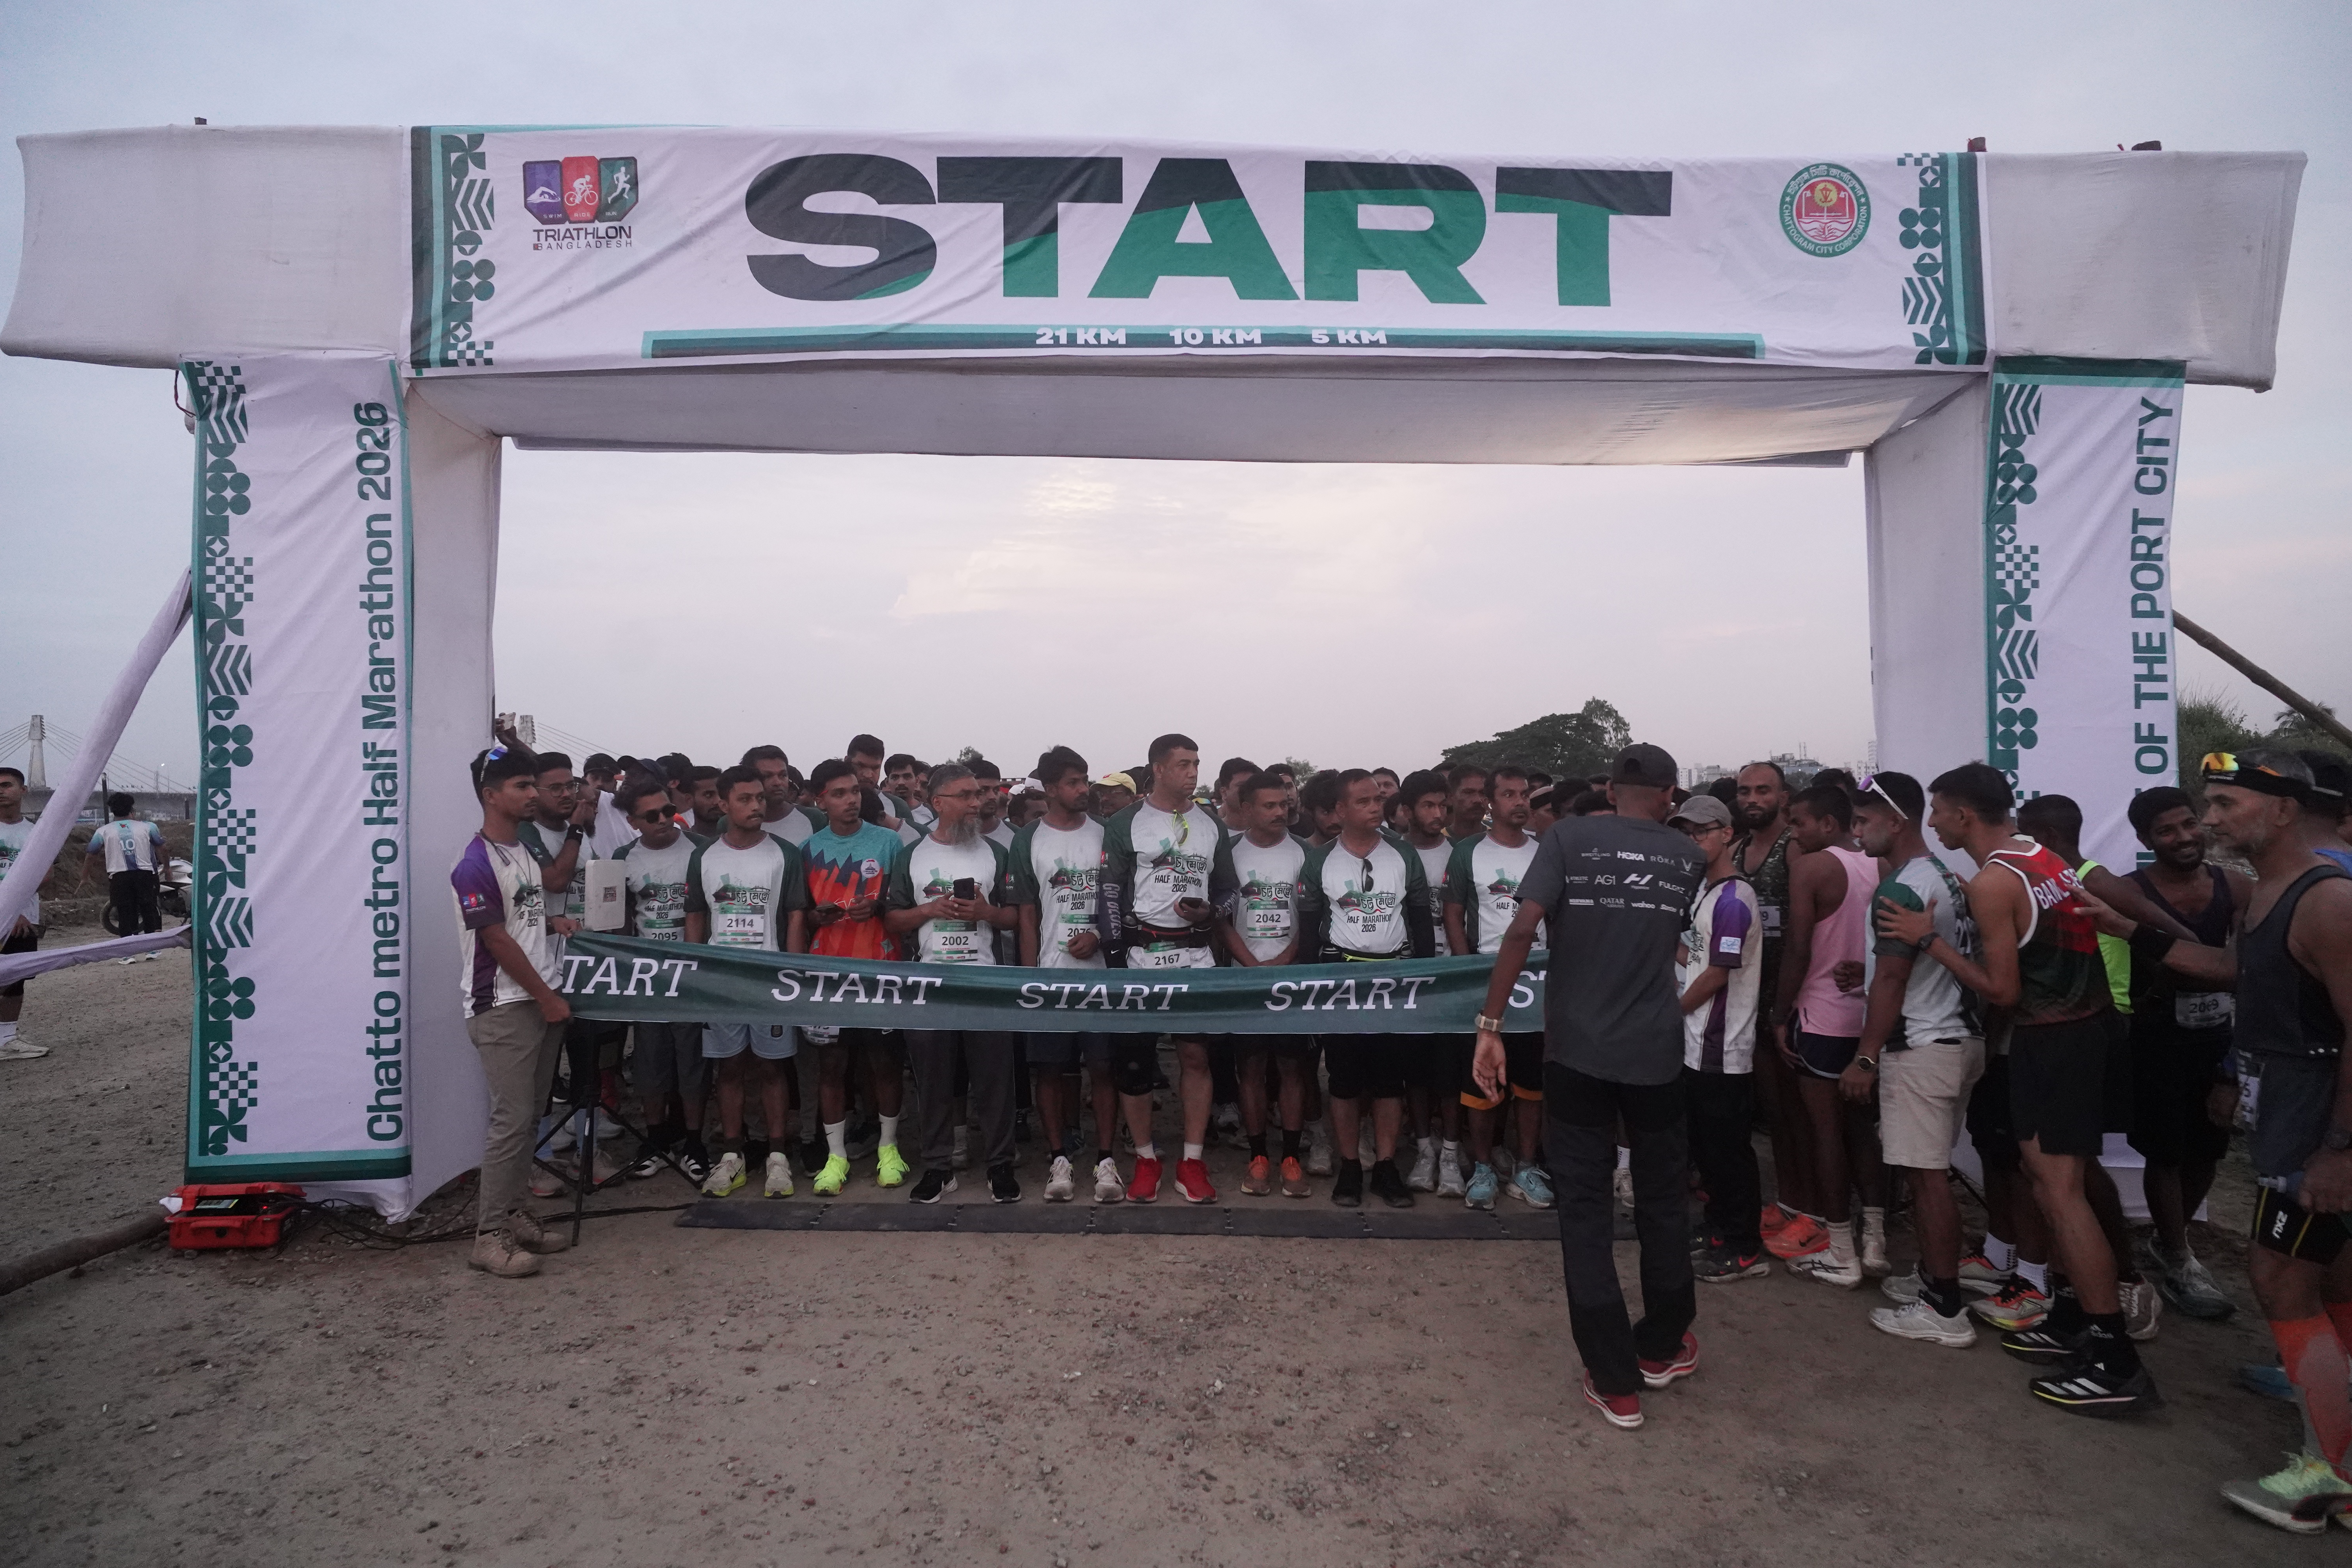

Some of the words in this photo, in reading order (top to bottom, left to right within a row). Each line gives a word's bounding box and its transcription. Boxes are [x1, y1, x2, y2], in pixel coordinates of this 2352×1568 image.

[533, 226, 632, 241] TRIATHLON
[746, 152, 1672, 307] START
[1783, 204, 1815, 251] CHATTOGRAM
[1815, 246, 1833, 254] CITY
[1835, 205, 1867, 252] CORPORATION
[537, 240, 632, 250] BANGLADESH
[1036, 327, 1067, 345] 21
[1077, 328, 1126, 345] KM
[1170, 328, 1204, 345] 10
[1212, 328, 1261, 345] KM
[1312, 329, 1330, 344] 5
[1337, 330, 1387, 344] KM
[354, 401, 391, 501] 2026
[2134, 396, 2173, 496] CITY
[2130, 508, 2165, 619] PORT
[359, 512, 397, 730] Marathon
[2132, 631, 2169, 713] THE
[2134, 722, 2169, 775] OF
[362, 741, 397, 826] Half
[119, 838, 135, 851] 10
[1617, 851, 1645, 861] HOKA
[1154, 875, 1171, 883] HALF
[1174, 875, 1203, 888] MARATHON
[1172, 884, 1187, 892] 2026
[1056, 894, 1069, 904] HALF
[1071, 892, 1099, 902] MARATHO
[1071, 901, 1085, 910] 2026
[1631, 901, 1655, 909] wahoo
[364, 837, 400, 978] metro
[726, 918, 754, 928] 2114
[1255, 914, 1281, 923] 2042
[651, 932, 678, 940] 2095
[1361, 924, 1376, 932] 2026
[942, 936, 969, 946] 2002
[1154, 953, 1180, 966] 2167
[561, 955, 699, 997] TART
[771, 969, 942, 1005] START
[1265, 976, 1437, 1011] START
[1016, 982, 1189, 1011] START
[366, 990, 403, 1142] Chatto
